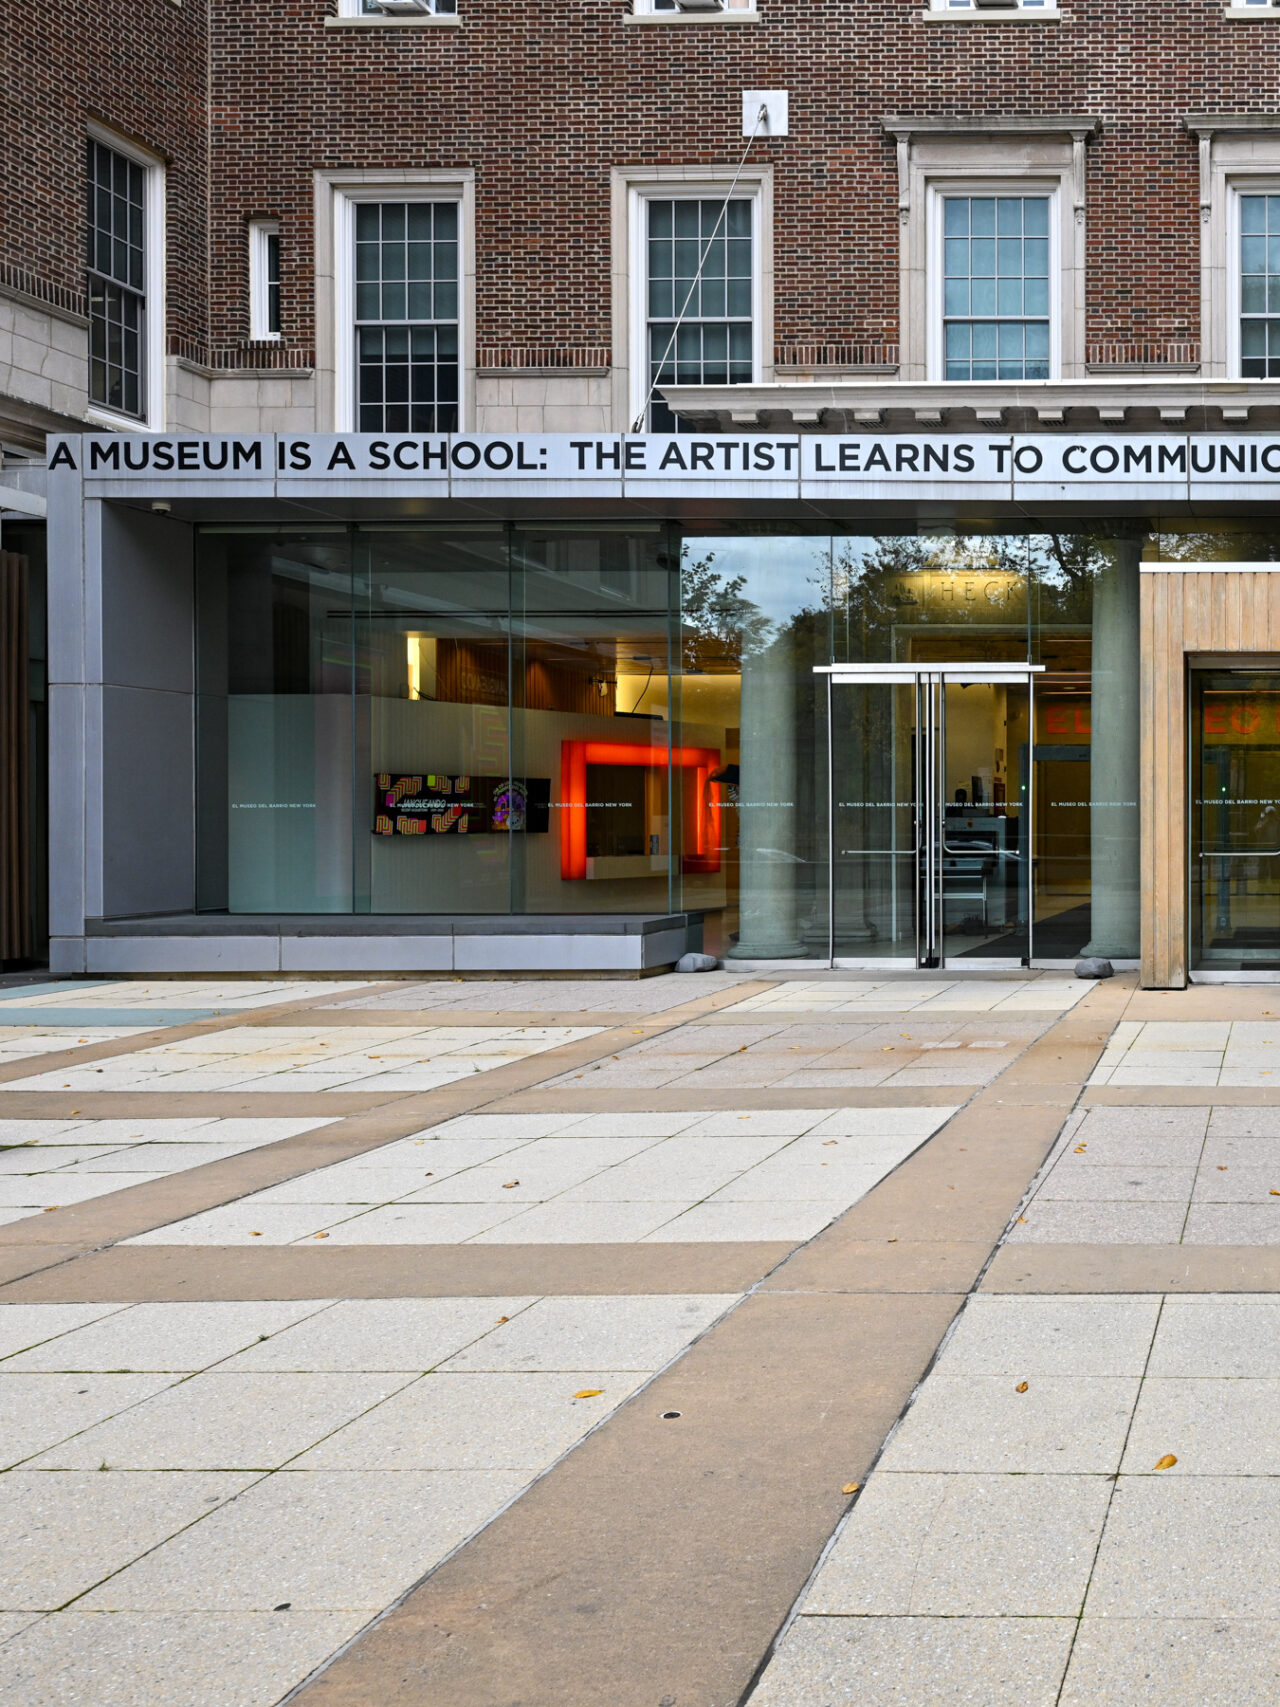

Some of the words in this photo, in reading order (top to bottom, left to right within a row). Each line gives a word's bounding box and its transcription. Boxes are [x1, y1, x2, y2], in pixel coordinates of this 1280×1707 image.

[49, 442, 77, 470] A
[90, 441, 262, 471] MUSEUM
[279, 441, 312, 471] IS
[327, 441, 355, 470] A
[369, 441, 547, 470] SCHOOL:
[570, 441, 647, 470] THE
[659, 441, 799, 471] ARTIST
[816, 443, 975, 472] LEARNS
[989, 445, 1043, 474] TO
[1046, 705, 1091, 734] EL
